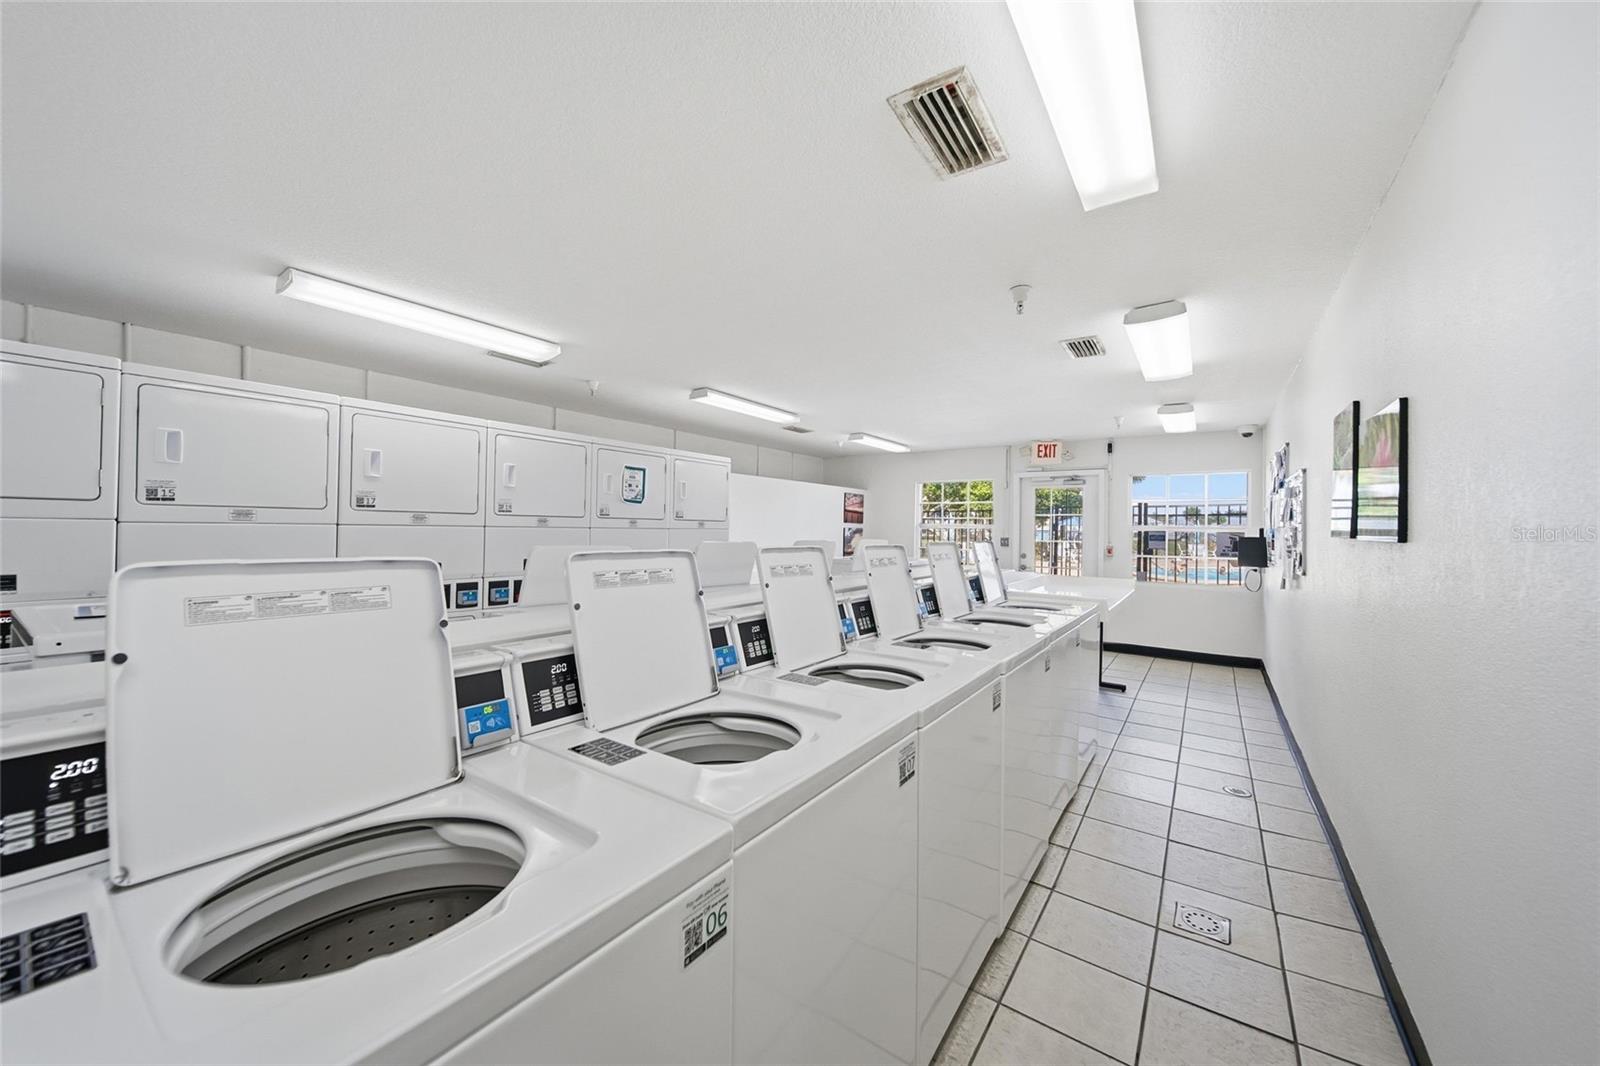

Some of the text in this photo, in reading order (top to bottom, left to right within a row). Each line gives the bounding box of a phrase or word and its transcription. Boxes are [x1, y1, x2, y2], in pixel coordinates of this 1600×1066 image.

[1037, 443, 1057, 458] EXIT
[160, 488, 176, 497] 15
[706, 902, 728, 936] 06
